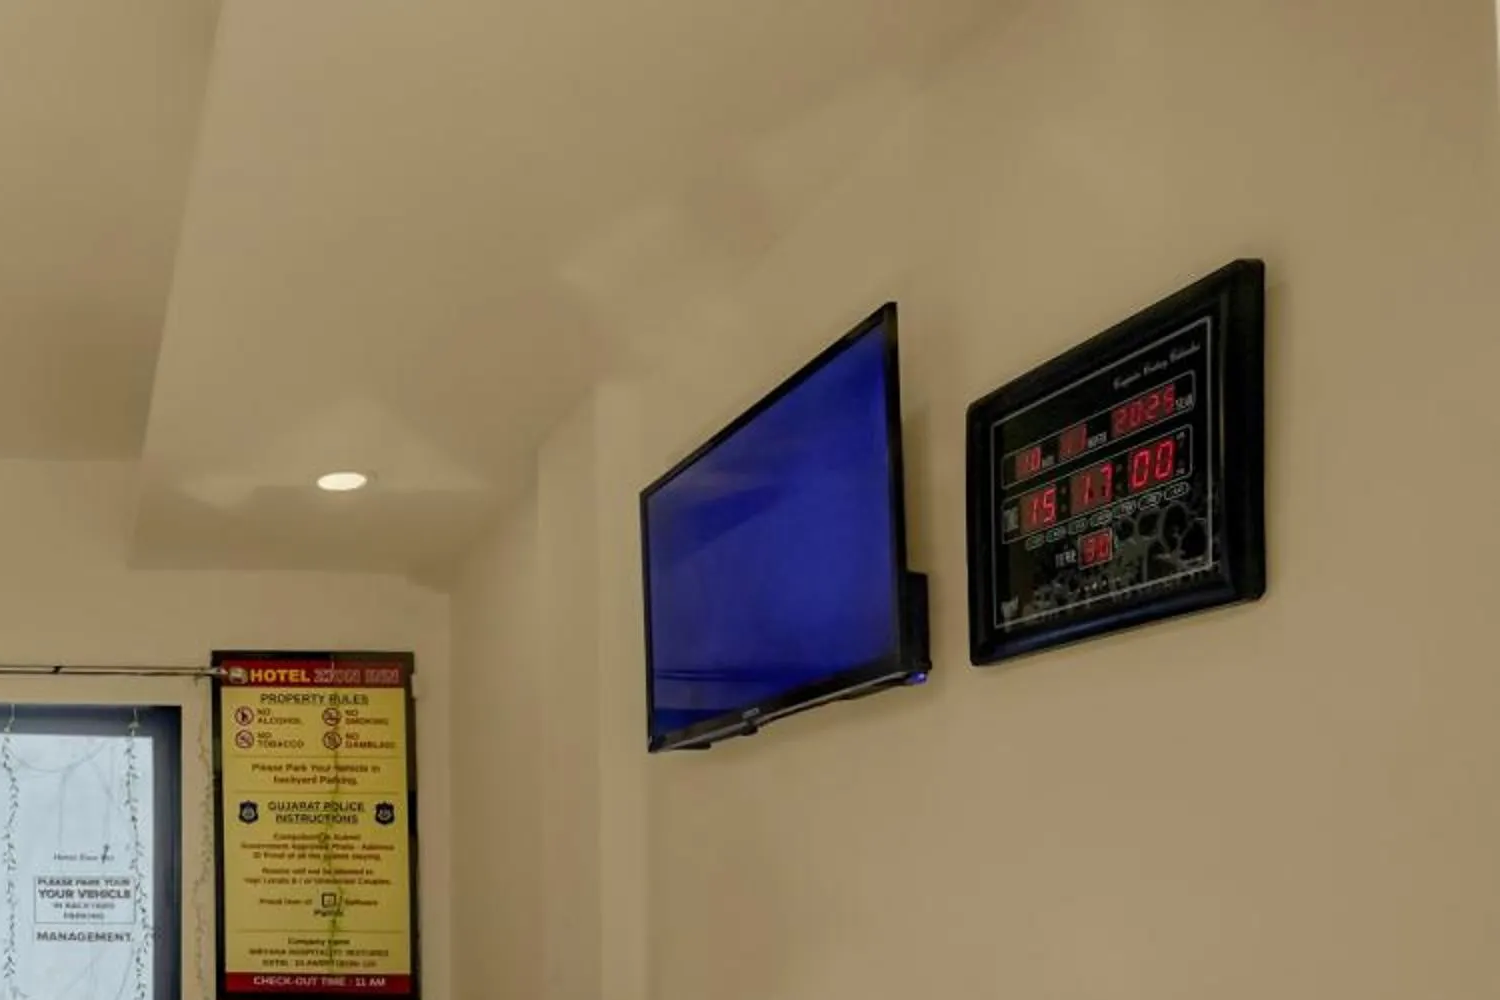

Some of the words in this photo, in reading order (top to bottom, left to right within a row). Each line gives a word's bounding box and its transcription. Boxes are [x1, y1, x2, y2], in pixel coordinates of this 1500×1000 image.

[251, 668, 312, 683] HOTEL
[260, 693, 325, 705] PROPERTY
[329, 694, 369, 706] RULES
[257, 708, 271, 716] NO
[345, 709, 359, 717] NO
[257, 717, 303, 725] ALCOHOL
[345, 718, 389, 726] SMOKING
[257, 731, 272, 739] NO
[345, 732, 360, 740] NO
[257, 740, 305, 748] TOBACCO
[267, 802, 321, 812] GUJARAT
[323, 802, 364, 813] POLICE
[275, 814, 359, 825] INSTRUCTIONS
[38, 889, 74, 899] YOUR
[78, 889, 131, 899] VEHICLE
[253, 976, 317, 986] CHECK-OUT
[321, 977, 346, 987] TIME
[368, 977, 386, 987] AM
